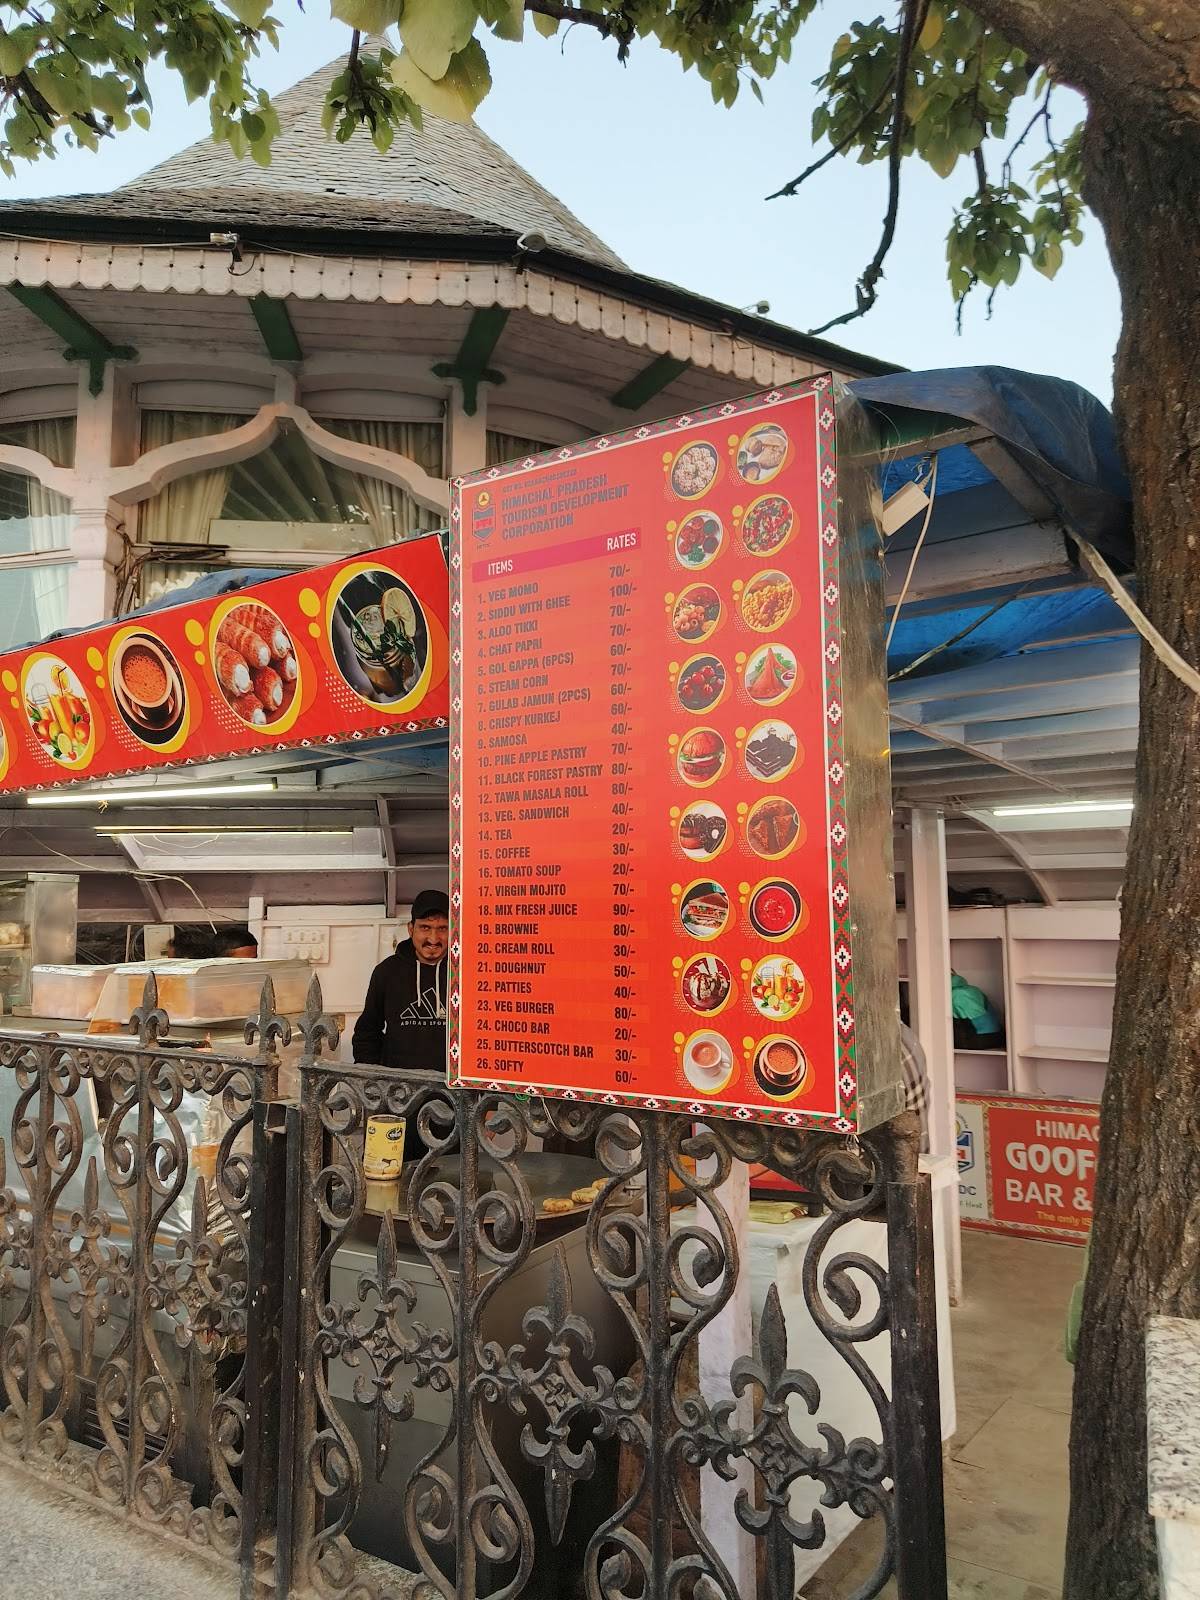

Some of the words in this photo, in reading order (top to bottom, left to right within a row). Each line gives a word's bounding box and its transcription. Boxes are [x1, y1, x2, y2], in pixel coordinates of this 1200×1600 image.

[502, 488, 553, 510] HIMACHAL
[557, 474, 607, 496] PRADESH
[502, 505, 547, 525] TOURISM
[550, 484, 629, 513] DEVELOPMENT
[502, 512, 574, 540] CORPORATION
[487, 559, 513, 576] ITEMS
[606, 532, 637, 551] RATES
[609, 563, 631, 578] 70/-
[478, 593, 486, 604] 1.
[489, 588, 506, 602] VEG
[508, 582, 539, 598] MOMO
[609, 583, 637, 597] 100/-
[477, 611, 486, 622] 2.
[489, 604, 515, 620] SIDDU
[519, 599, 543, 614] WITH
[545, 594, 570, 609] GHEE
[609, 602, 631, 617] 70/-
[478, 630, 487, 640] 3.
[489, 624, 511, 638] ALOO
[515, 619, 538, 633] TIKKI
[610, 623, 631, 637] 70/-
[478, 648, 487, 658] 4.
[489, 643, 512, 656] CHAT
[515, 638, 542, 652] PAPRI
[610, 642, 632, 656] 60/-
[478, 666, 487, 676] 5.
[489, 663, 507, 674] GOL
[509, 657, 539, 672] GAPPA
[610, 662, 632, 676] 70/-
[478, 684, 487, 695] 6.
[489, 679, 519, 693] STEAM
[523, 674, 549, 688] CORN
[610, 682, 632, 696] 60/-
[477, 702, 487, 713] 7.
[489, 698, 518, 711] GULAB
[521, 693, 555, 707] JAMUN
[558, 688, 591, 704] (2PCS)
[611, 702, 633, 715] 60/-
[478, 720, 487, 731] 8.
[489, 715, 522, 729] CRISPY
[611, 722, 633, 735] 40/-
[478, 739, 487, 749] 9.
[489, 734, 527, 748] SAMOSA
[611, 742, 633, 755] 70/-
[479, 757, 492, 767] 10.
[495, 753, 516, 766] PINE
[519, 750, 549, 763] APPLE
[551, 746, 587, 760] PASTRY
[479, 775, 493, 786] 11.
[495, 772, 525, 784] BLACK
[528, 768, 564, 782] FOREST
[566, 765, 603, 778] PASTRY
[611, 762, 633, 775] 80/-
[479, 793, 493, 804] 12.
[495, 790, 520, 803] TAWA
[523, 787, 561, 801] MASALA
[564, 785, 589, 798] ROLL
[611, 782, 633, 795] 80/-
[479, 812, 493, 822] 13.
[495, 810, 516, 821] VEG.
[519, 806, 570, 820] SANDWICH
[612, 802, 633, 815] 40/-
[479, 830, 493, 841] 14.
[495, 829, 512, 840] TEA
[612, 822, 634, 835] 20/-
[479, 849, 493, 859] 15.
[495, 846, 531, 859] COFFEE
[612, 842, 634, 856] 30/-
[479, 867, 493, 878] 16.
[495, 865, 533, 877] TOMATO
[536, 865, 562, 876] SOUP
[612, 863, 634, 876] 20/-
[479, 886, 493, 897] 17.
[495, 885, 527, 896] VIRGIN
[529, 884, 567, 896] MOJITO
[612, 883, 634, 896] 70/-
[478, 905, 493, 915] 18.
[495, 904, 513, 915] MIX
[515, 904, 546, 915] FRESH
[549, 904, 578, 915] JUICE
[612, 904, 634, 917] 90/-
[478, 924, 492, 934] 19.
[495, 924, 539, 935] BROWNIE
[613, 924, 635, 937] 80/-
[477, 943, 492, 954] 20.
[495, 943, 528, 954] CREAM
[531, 943, 555, 955] ROLL
[613, 944, 636, 958] 30/-
[477, 962, 492, 973] 21.
[495, 962, 546, 974] DOUGHNUT
[613, 965, 636, 979] 50/-
[477, 981, 492, 992] 22.
[495, 981, 532, 993] PATTIES
[614, 986, 636, 1000] 40/-
[477, 1000, 492, 1011] 23.
[495, 1001, 513, 1012] VEG
[516, 1002, 555, 1014] BURGER
[614, 1007, 637, 1021] 80/-
[477, 1019, 492, 1031] 24.
[495, 1020, 528, 1033] CHOCO
[531, 1022, 550, 1035] BAR
[614, 1028, 637, 1042] 20/-
[477, 1039, 492, 1050] 25.
[495, 1040, 570, 1057] BUTTERSCOTCH
[573, 1045, 594, 1058] BAR
[615, 1049, 637, 1063] 30/-
[476, 1058, 492, 1070] 26.
[495, 1060, 524, 1073] SOFTY
[615, 1070, 638, 1085] 60/-
[1005, 1178, 1064, 1208] BAR
